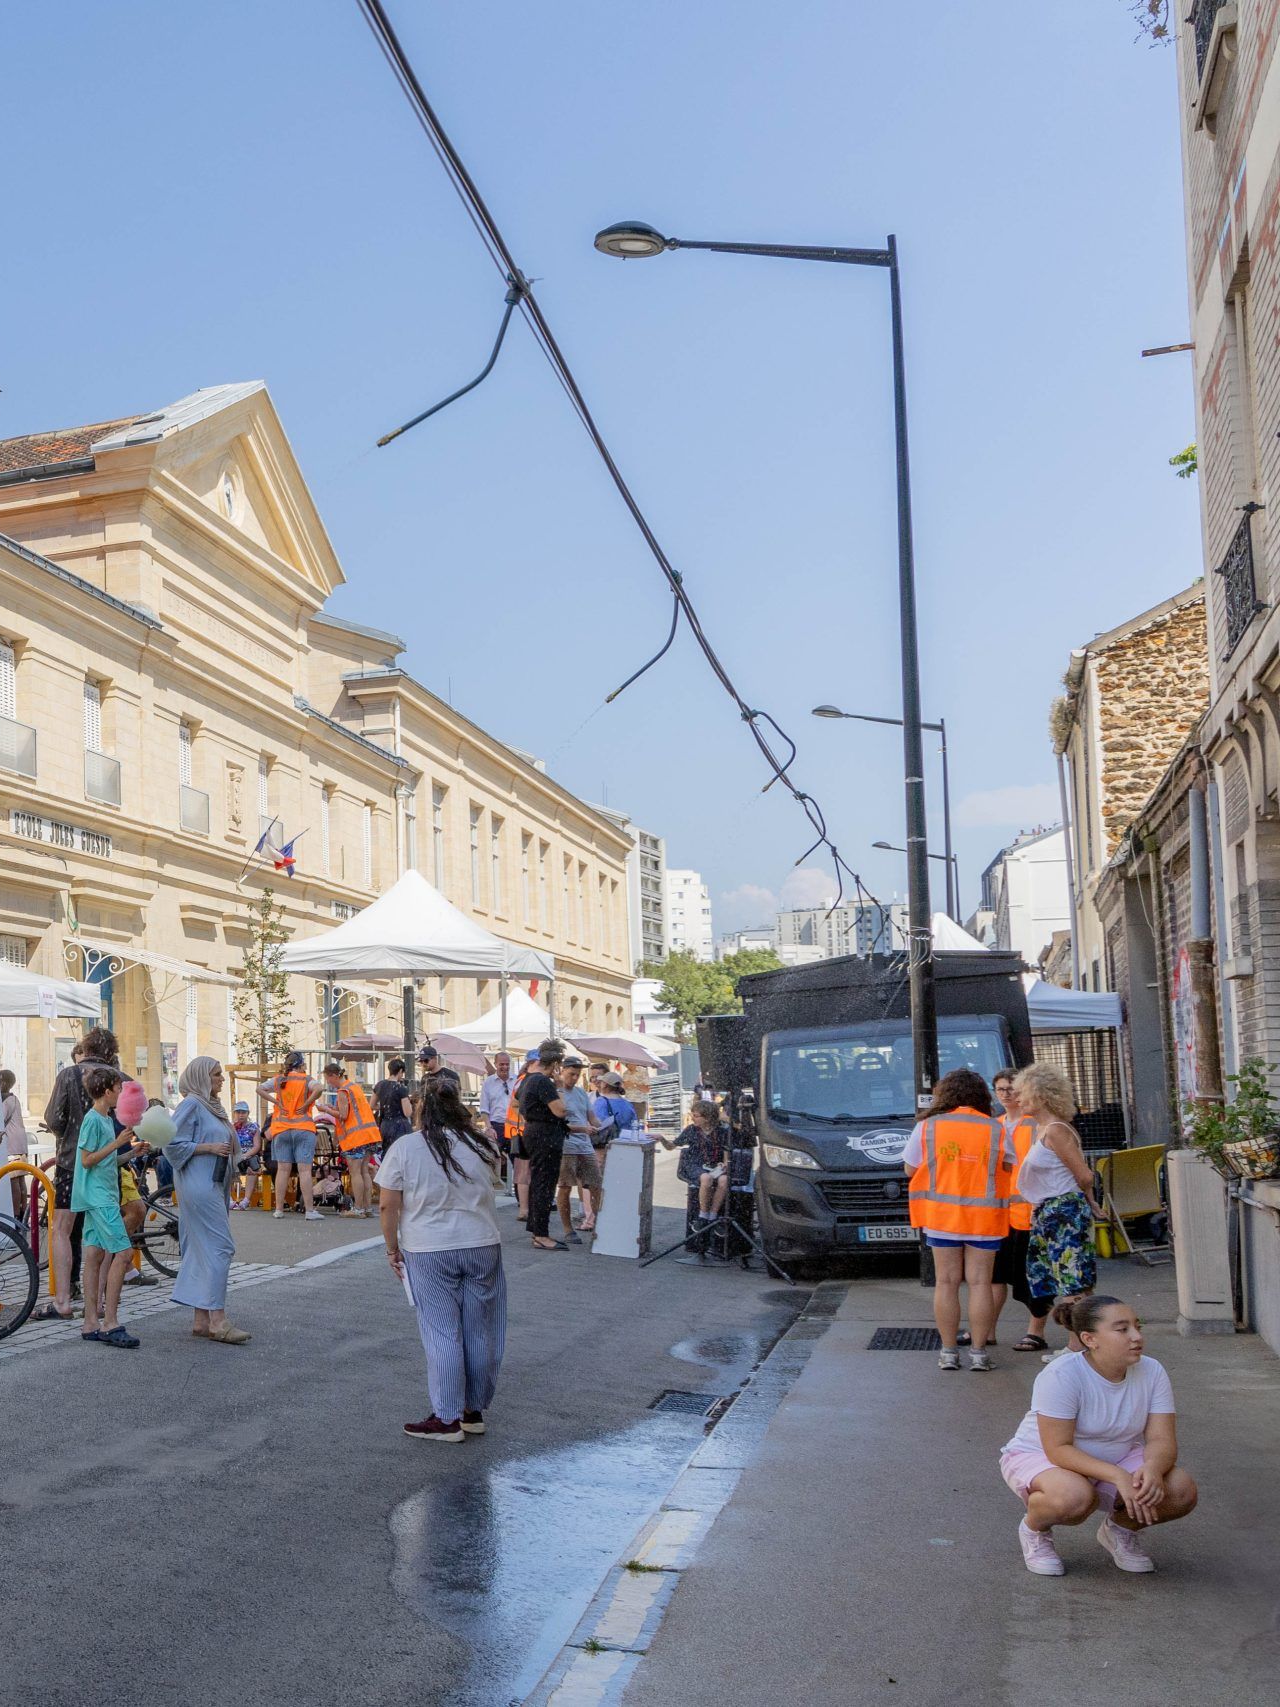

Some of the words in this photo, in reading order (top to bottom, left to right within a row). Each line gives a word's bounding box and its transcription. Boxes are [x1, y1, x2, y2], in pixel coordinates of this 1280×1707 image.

[50, 821, 74, 848] JULES
[81, 830, 111, 858] GUESDE
[860, 1138, 887, 1147] CAMION
